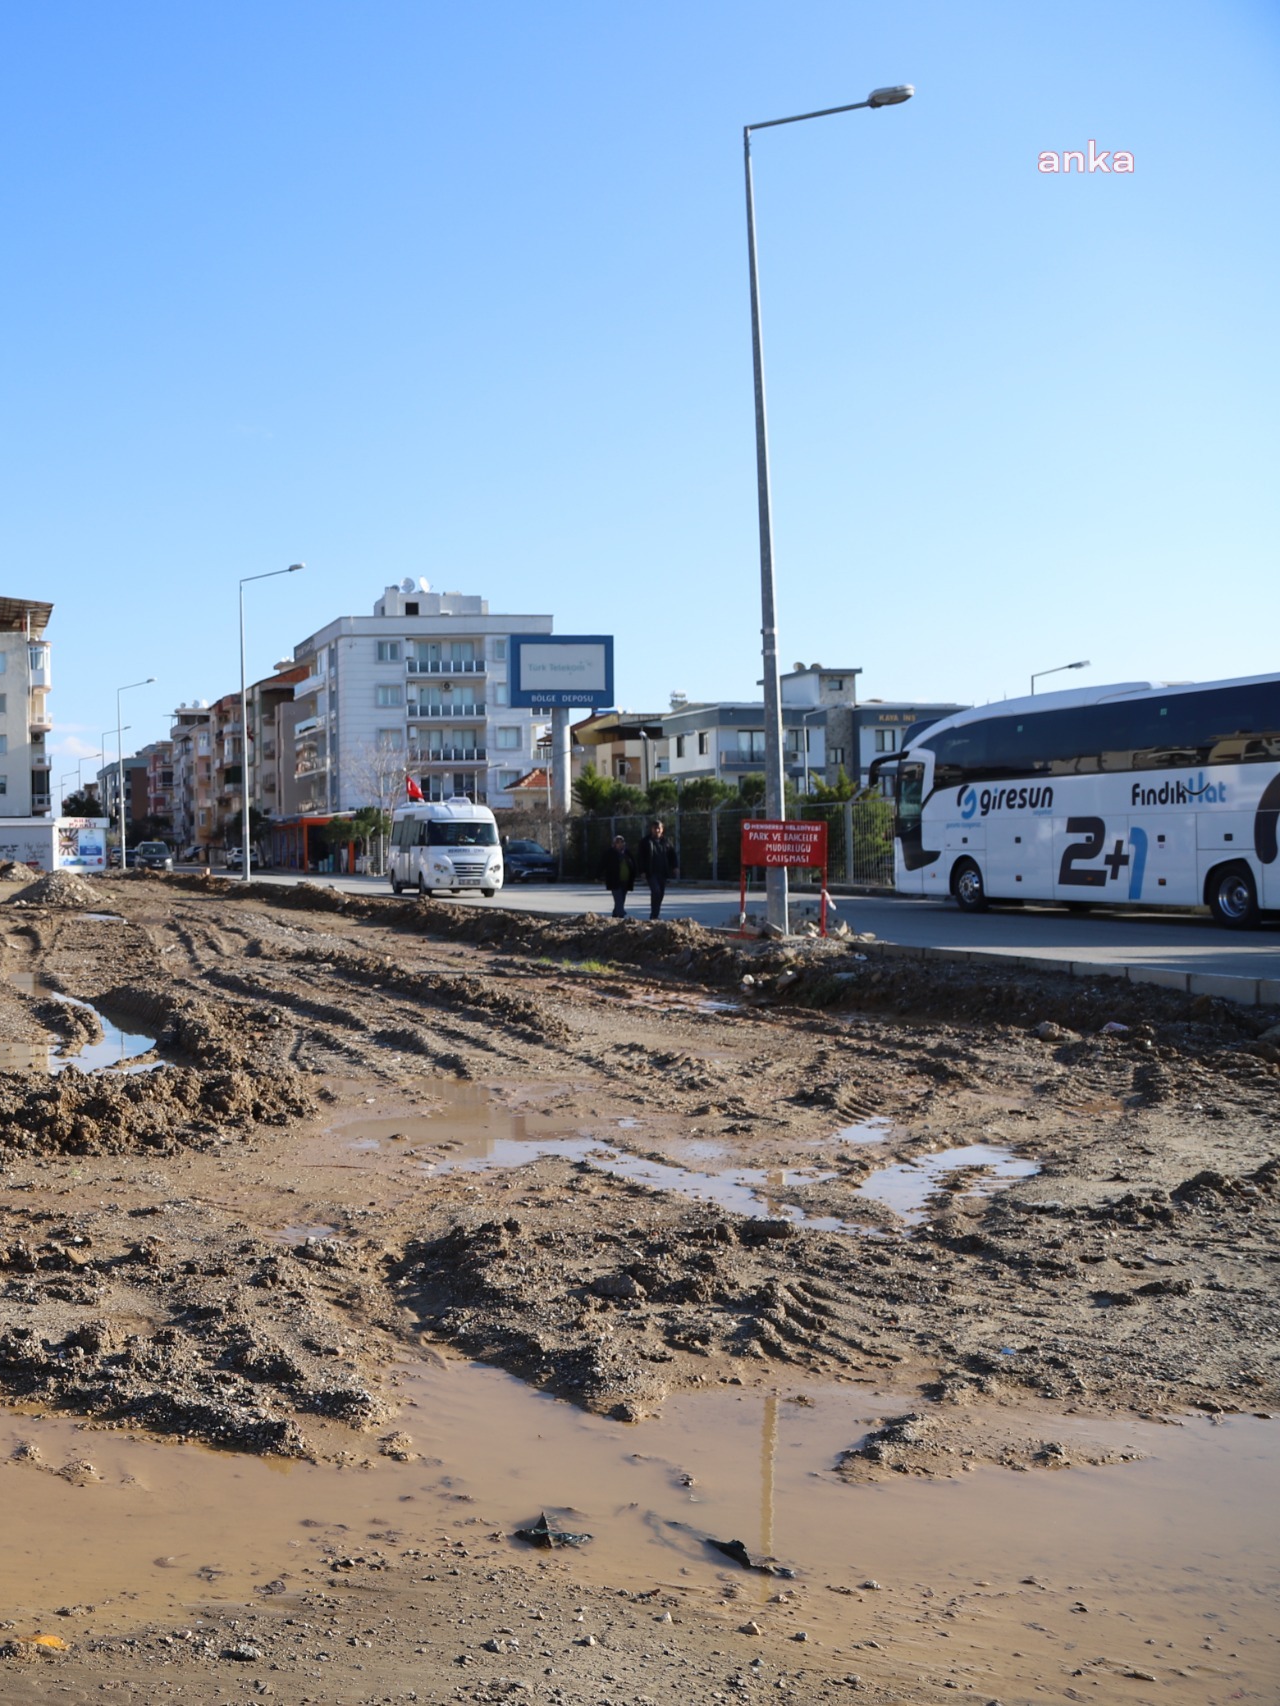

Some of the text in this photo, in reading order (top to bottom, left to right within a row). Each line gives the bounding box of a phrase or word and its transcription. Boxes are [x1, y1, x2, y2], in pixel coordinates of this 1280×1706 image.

[531, 693, 593, 703] BÖLGE DEPOSU
[980, 786, 1054, 817] giresun
[749, 831, 769, 841] PARK
[772, 833, 782, 841] VE
[1058, 816, 1148, 900] 2+1
